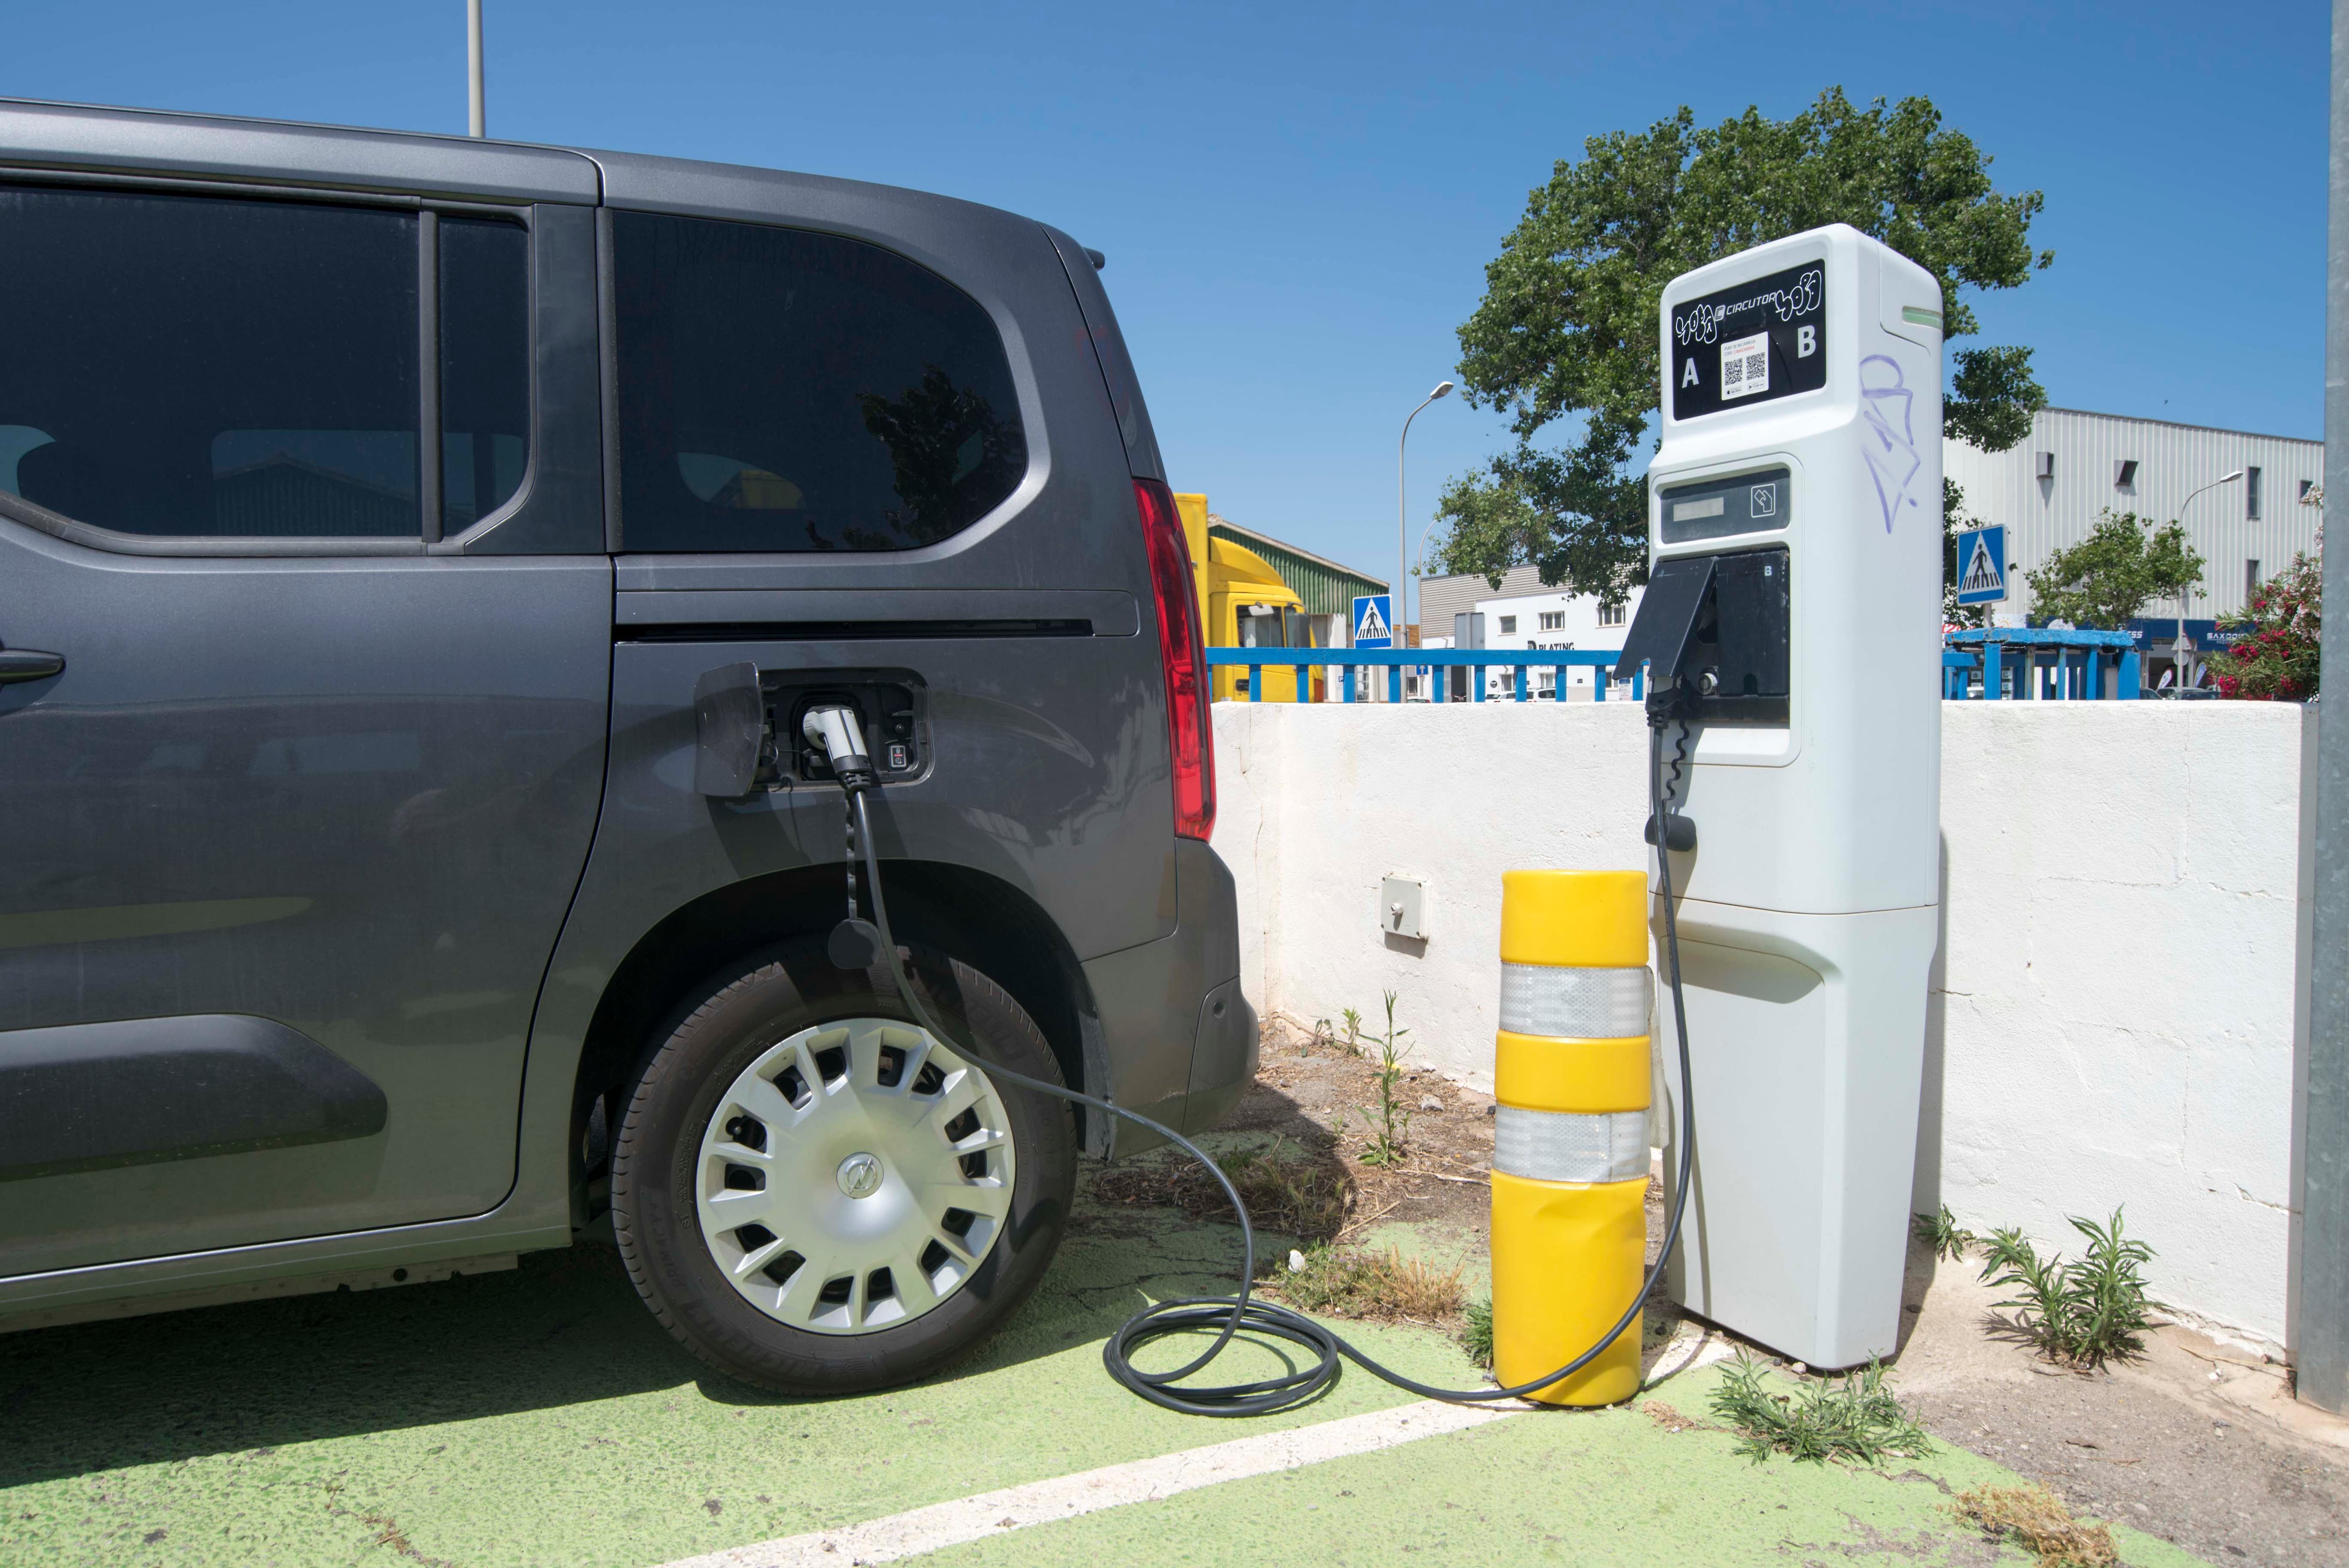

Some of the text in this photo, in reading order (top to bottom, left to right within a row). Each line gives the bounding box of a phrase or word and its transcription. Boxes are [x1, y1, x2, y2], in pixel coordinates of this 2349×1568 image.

[1727, 292, 1776, 315] CIRCUTOR
[1797, 325, 1816, 358] B
[1681, 357, 1700, 389] A
[1765, 566, 1772, 576] B
